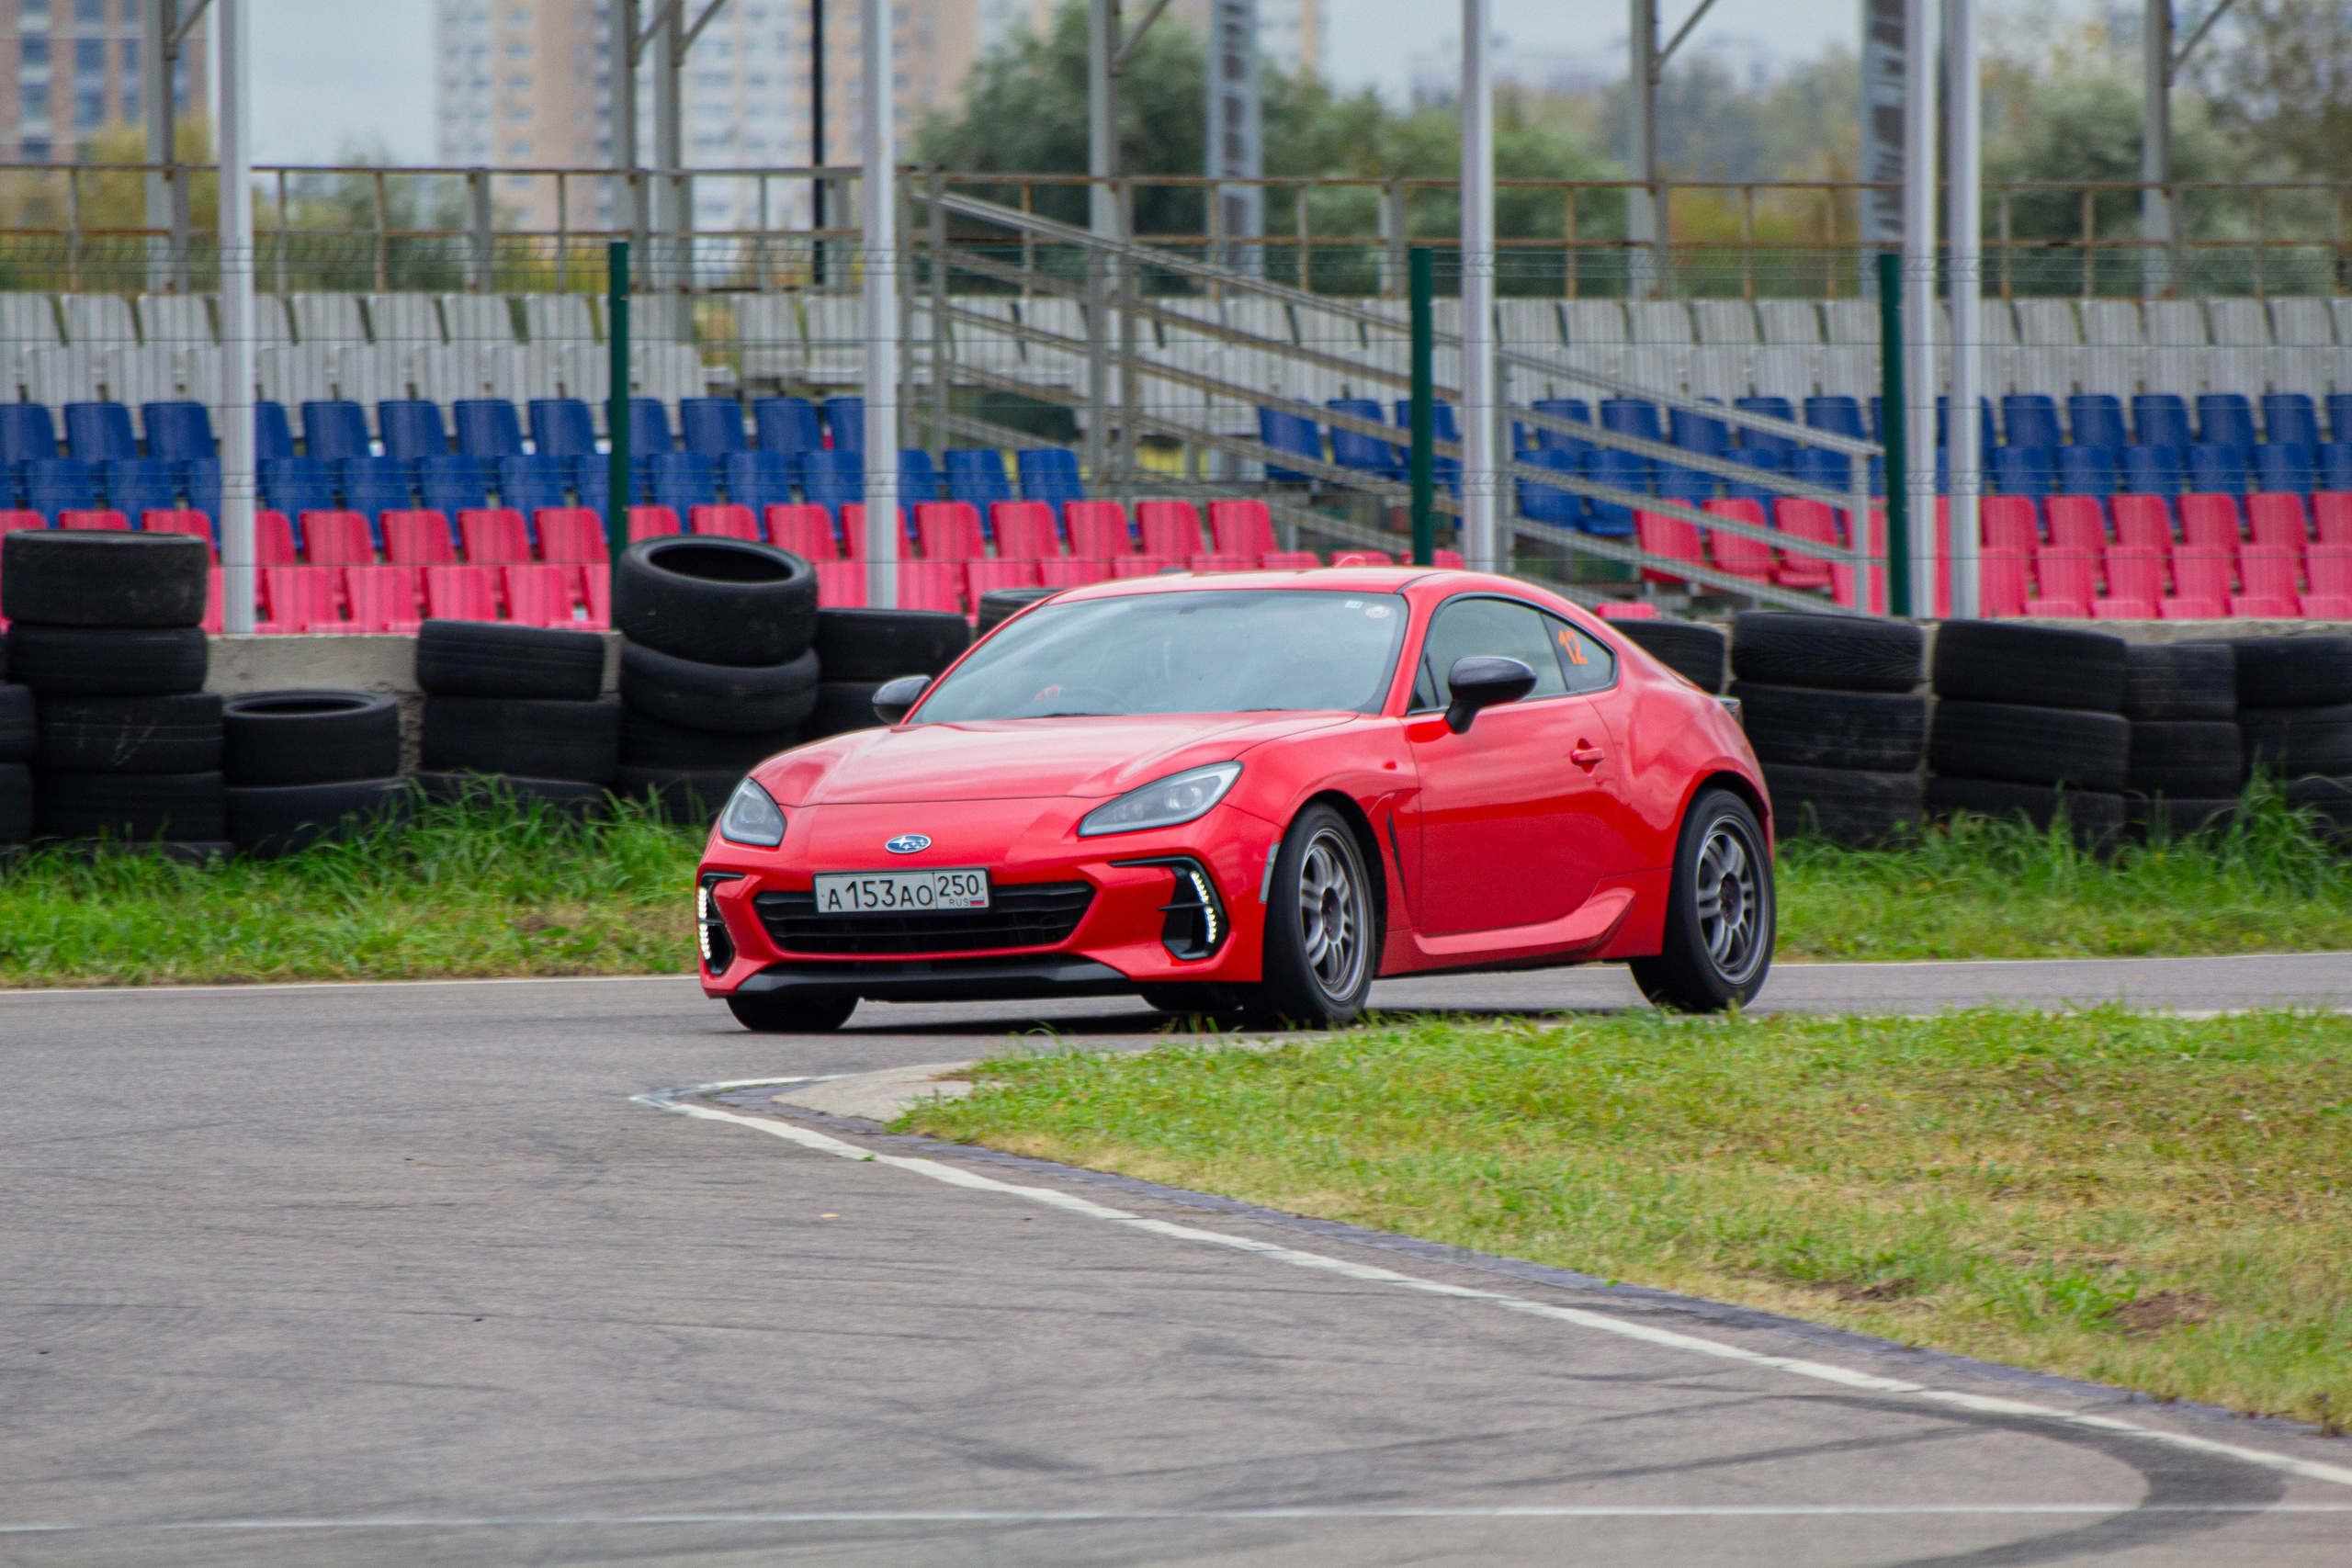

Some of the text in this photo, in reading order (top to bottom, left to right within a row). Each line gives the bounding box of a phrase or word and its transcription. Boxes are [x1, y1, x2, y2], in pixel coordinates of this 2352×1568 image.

[1558, 629, 1589, 665] 12
[937, 874, 979, 897] 250
[948, 897, 969, 907] RUS
